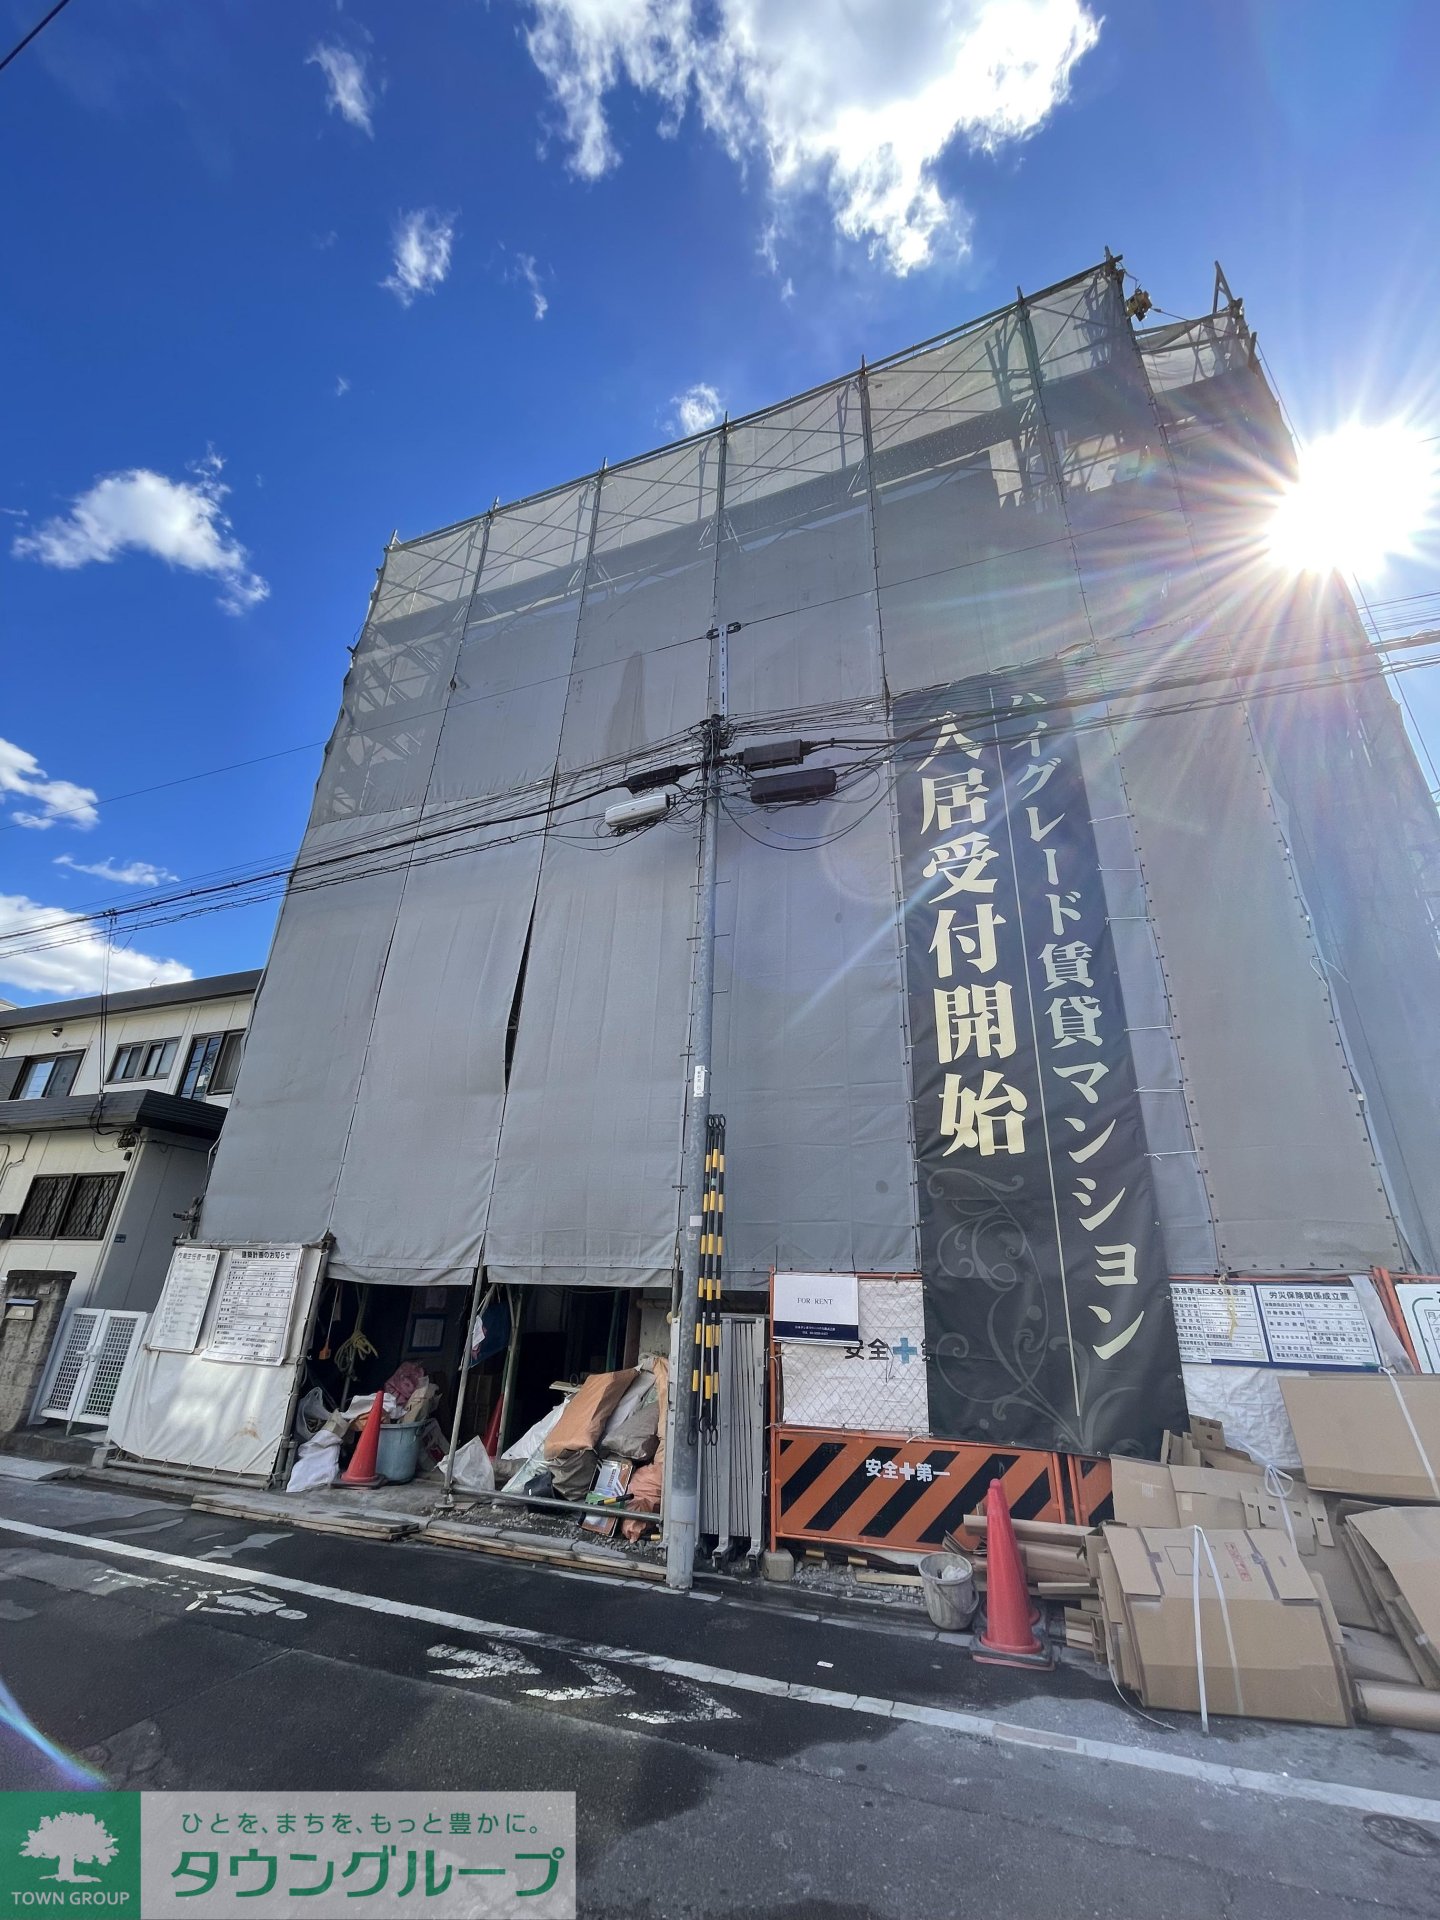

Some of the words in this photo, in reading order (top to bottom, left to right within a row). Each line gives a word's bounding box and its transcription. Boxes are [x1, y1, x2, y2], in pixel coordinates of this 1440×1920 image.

[916, 712, 1027, 1157] 入居受付開始
[1006, 691, 1145, 1361] ハイグレード賃貸マンション
[241, 1250, 291, 1260] 建築計画のお知らせ
[1269, 1291, 1350, 1301] 労災保険関係成立票
[865, 1458, 898, 1480] 安全
[915, 1461, 951, 1483] 第一
